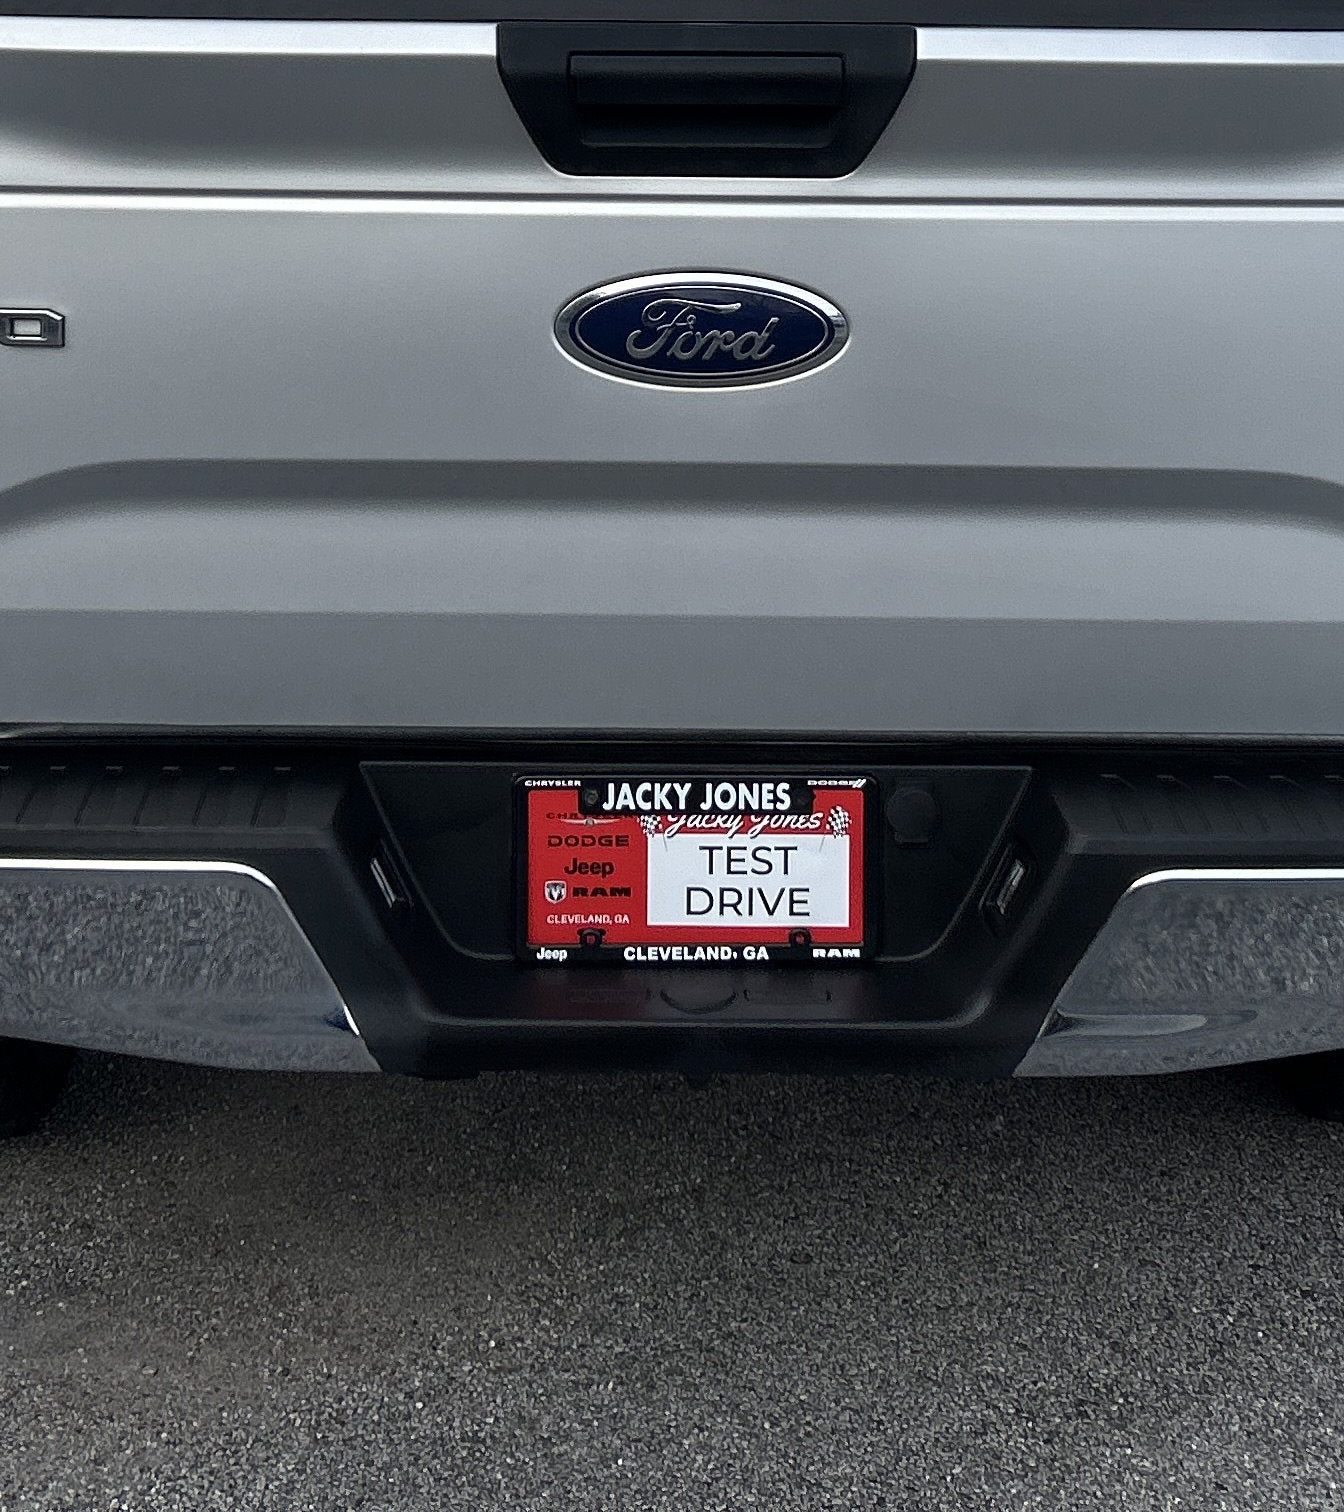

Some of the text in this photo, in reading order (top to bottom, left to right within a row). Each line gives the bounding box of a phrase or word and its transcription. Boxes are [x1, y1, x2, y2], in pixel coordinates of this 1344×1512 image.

[625, 297, 780, 361] Ford
[602, 782, 792, 811] JACKY JONES
[547, 835, 630, 847] DODGE
[564, 857, 615, 878] Jeep
[698, 845, 798, 876] TEST
[572, 886, 632, 898] RAM
[686, 886, 811, 917] DRIVE
[614, 914, 630, 925] GA
[536, 946, 568, 962] Jeep
[742, 946, 770, 961] GA
[812, 948, 861, 958] RAM
